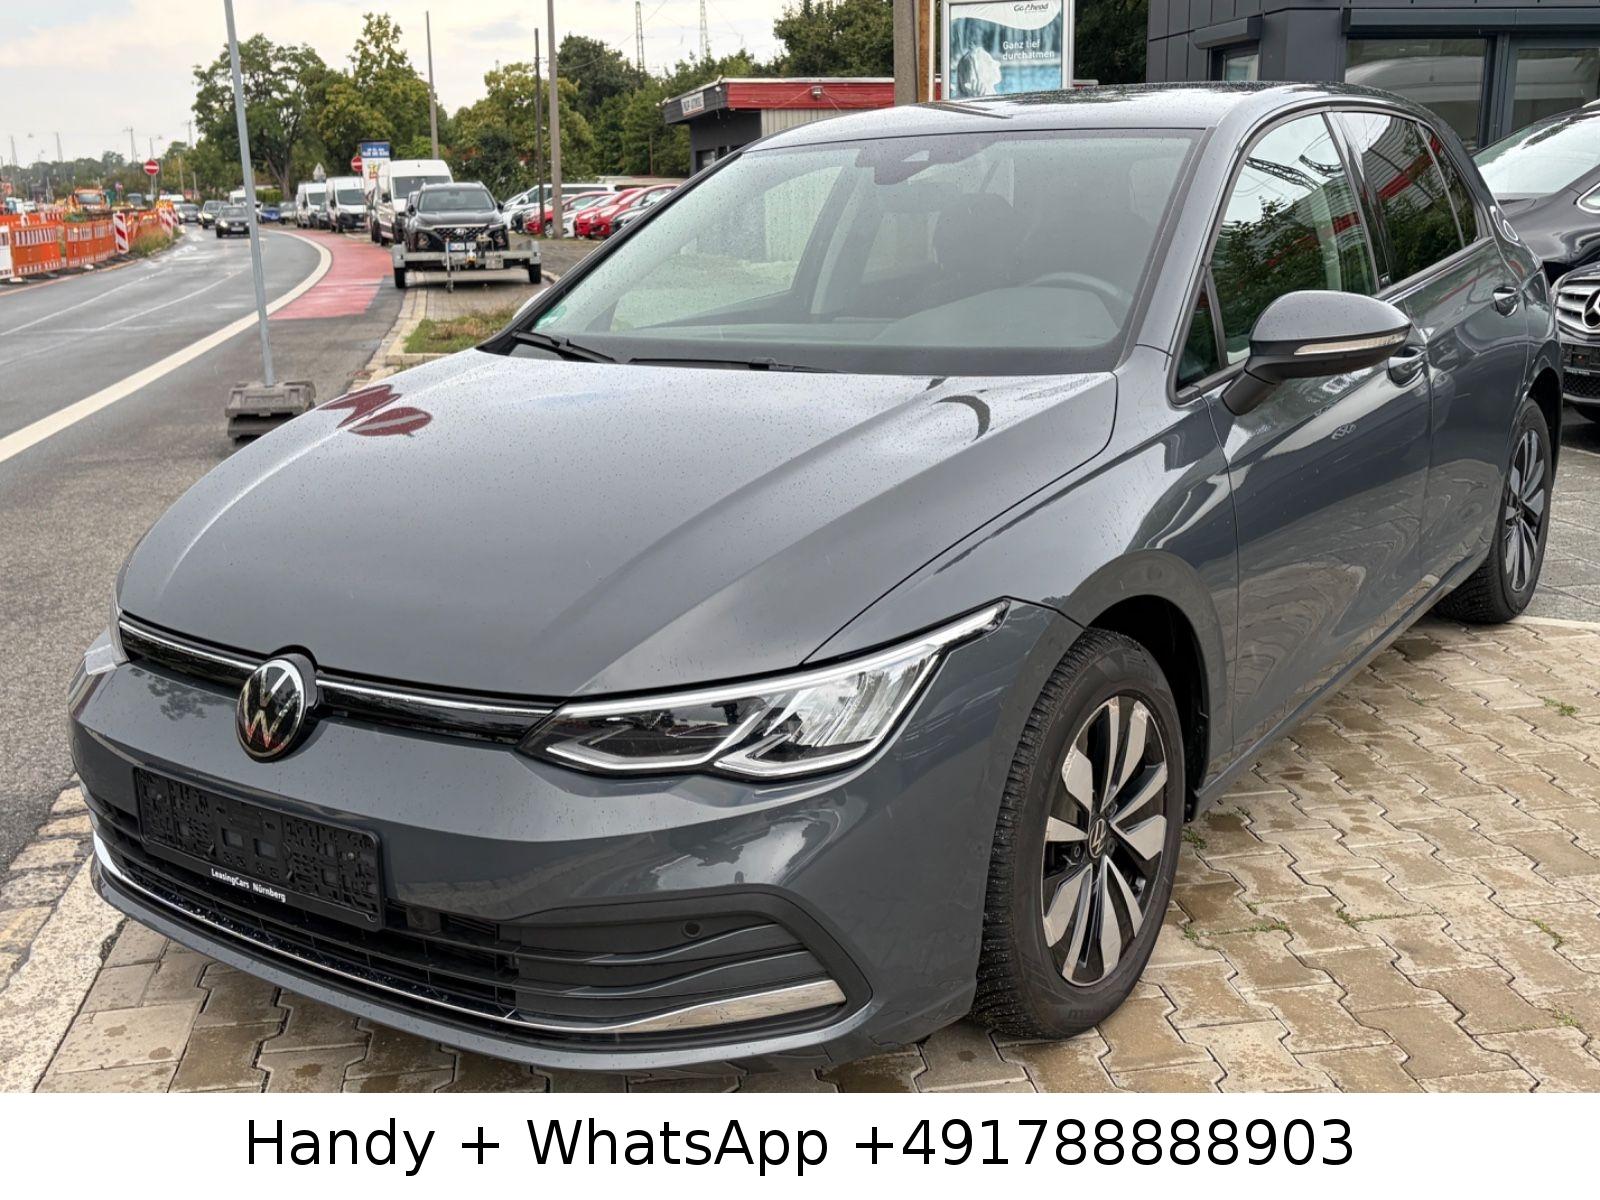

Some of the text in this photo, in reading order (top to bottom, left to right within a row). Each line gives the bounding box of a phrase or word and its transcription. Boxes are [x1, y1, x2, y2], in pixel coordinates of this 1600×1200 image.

[1002, 39, 1041, 50] Ganz tief
[1002, 50, 1055, 60] durchatmen
[239, 660, 303, 755] VW
[211, 868, 286, 903] LeasingCars Nürnberg
